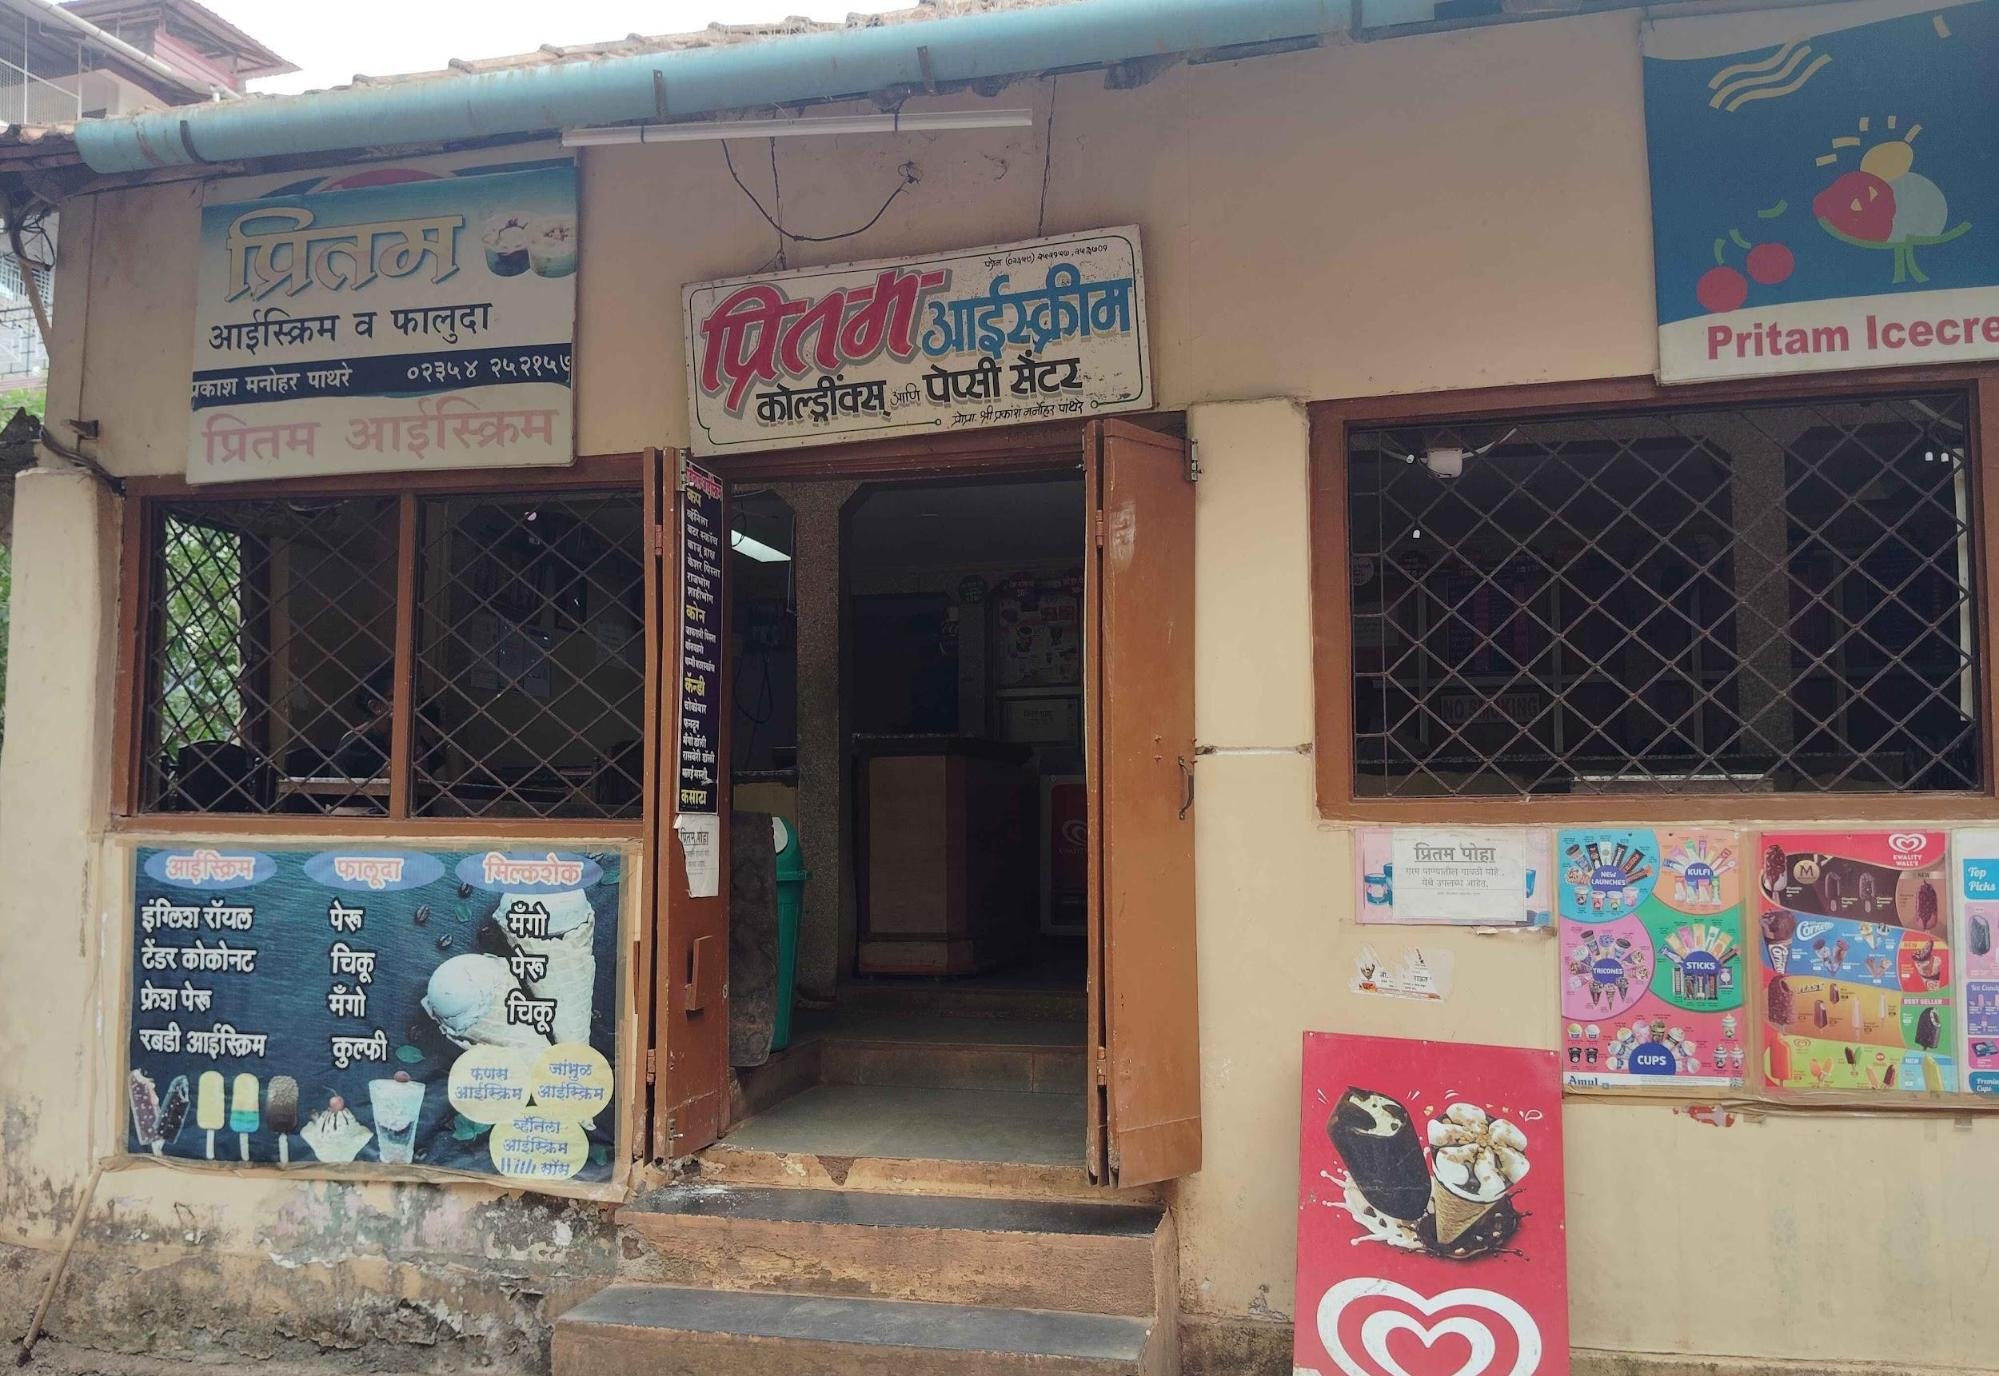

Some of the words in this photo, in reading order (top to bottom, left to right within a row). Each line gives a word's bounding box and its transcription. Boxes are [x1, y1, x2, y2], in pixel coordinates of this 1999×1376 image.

[225, 207, 463, 302] प्रितम
[209, 308, 339, 354] आईस्क्रिम
[353, 312, 376, 338] व
[391, 303, 492, 344] फालुदा
[701, 269, 948, 413] प्रितम
[922, 263, 1133, 360] आईस्क्रीम
[1707, 321, 1850, 361] Pritam
[245, 367, 300, 394] मनोहर
[307, 361, 352, 388] पाथरे
[407, 360, 478, 383] ०२३५४
[891, 382, 920, 407] आणि
[922, 356, 1002, 403] पेप्सी
[1010, 349, 1083, 394] सेंटर
[201, 413, 321, 465] प्रितम
[345, 396, 560, 460] आईस्क्रिम
[686, 601, 706, 625] कोन
[1444, 699, 1464, 719] NO
[167, 849, 255, 884] आईस्क्रिम
[1413, 841, 1456, 861] प्रितम
[1460, 841, 1496, 862] पोहा
[334, 857, 404, 889] फालूदा
[483, 852, 583, 885] मिल्कशेक
[1591, 878, 1626, 886] LAUNCHES
[1687, 868, 1711, 876] KULFI
[1968, 866, 1987, 880] Top
[1968, 881, 1997, 892] Picks
[141, 897, 200, 933] इंग्लिश
[202, 899, 253, 930] रॉयल
[329, 900, 364, 931] पेरू
[508, 903, 548, 937] मँगो
[141, 938, 178, 970] टेंडर
[181, 938, 257, 973] कोकोनट
[330, 942, 376, 984] चिकू
[511, 947, 546, 980] पेरू
[1593, 967, 1623, 975] TRICONES
[1686, 961, 1716, 971] STICKS
[140, 979, 178, 1012] फ्रेश
[181, 980, 212, 1012] पेरू
[328, 984, 367, 1017] मँगो
[507, 990, 555, 1033] चिकू
[139, 1021, 181, 1053] रबडी
[186, 1023, 268, 1060] आईस्क्रिम
[331, 1029, 388, 1069] कुल्फी
[470, 1066, 509, 1081] फणस
[549, 1059, 592, 1081] जांभुळ
[1637, 1055, 1667, 1066] CUPS
[455, 1082, 523, 1101] आईस्क्रिम
[538, 1082, 604, 1101] आईस्क्रिम
[1568, 1075, 1599, 1087] Amul
[504, 1136, 568, 1155] आईस्क्रिम
[540, 1159, 570, 1176] सॉस
